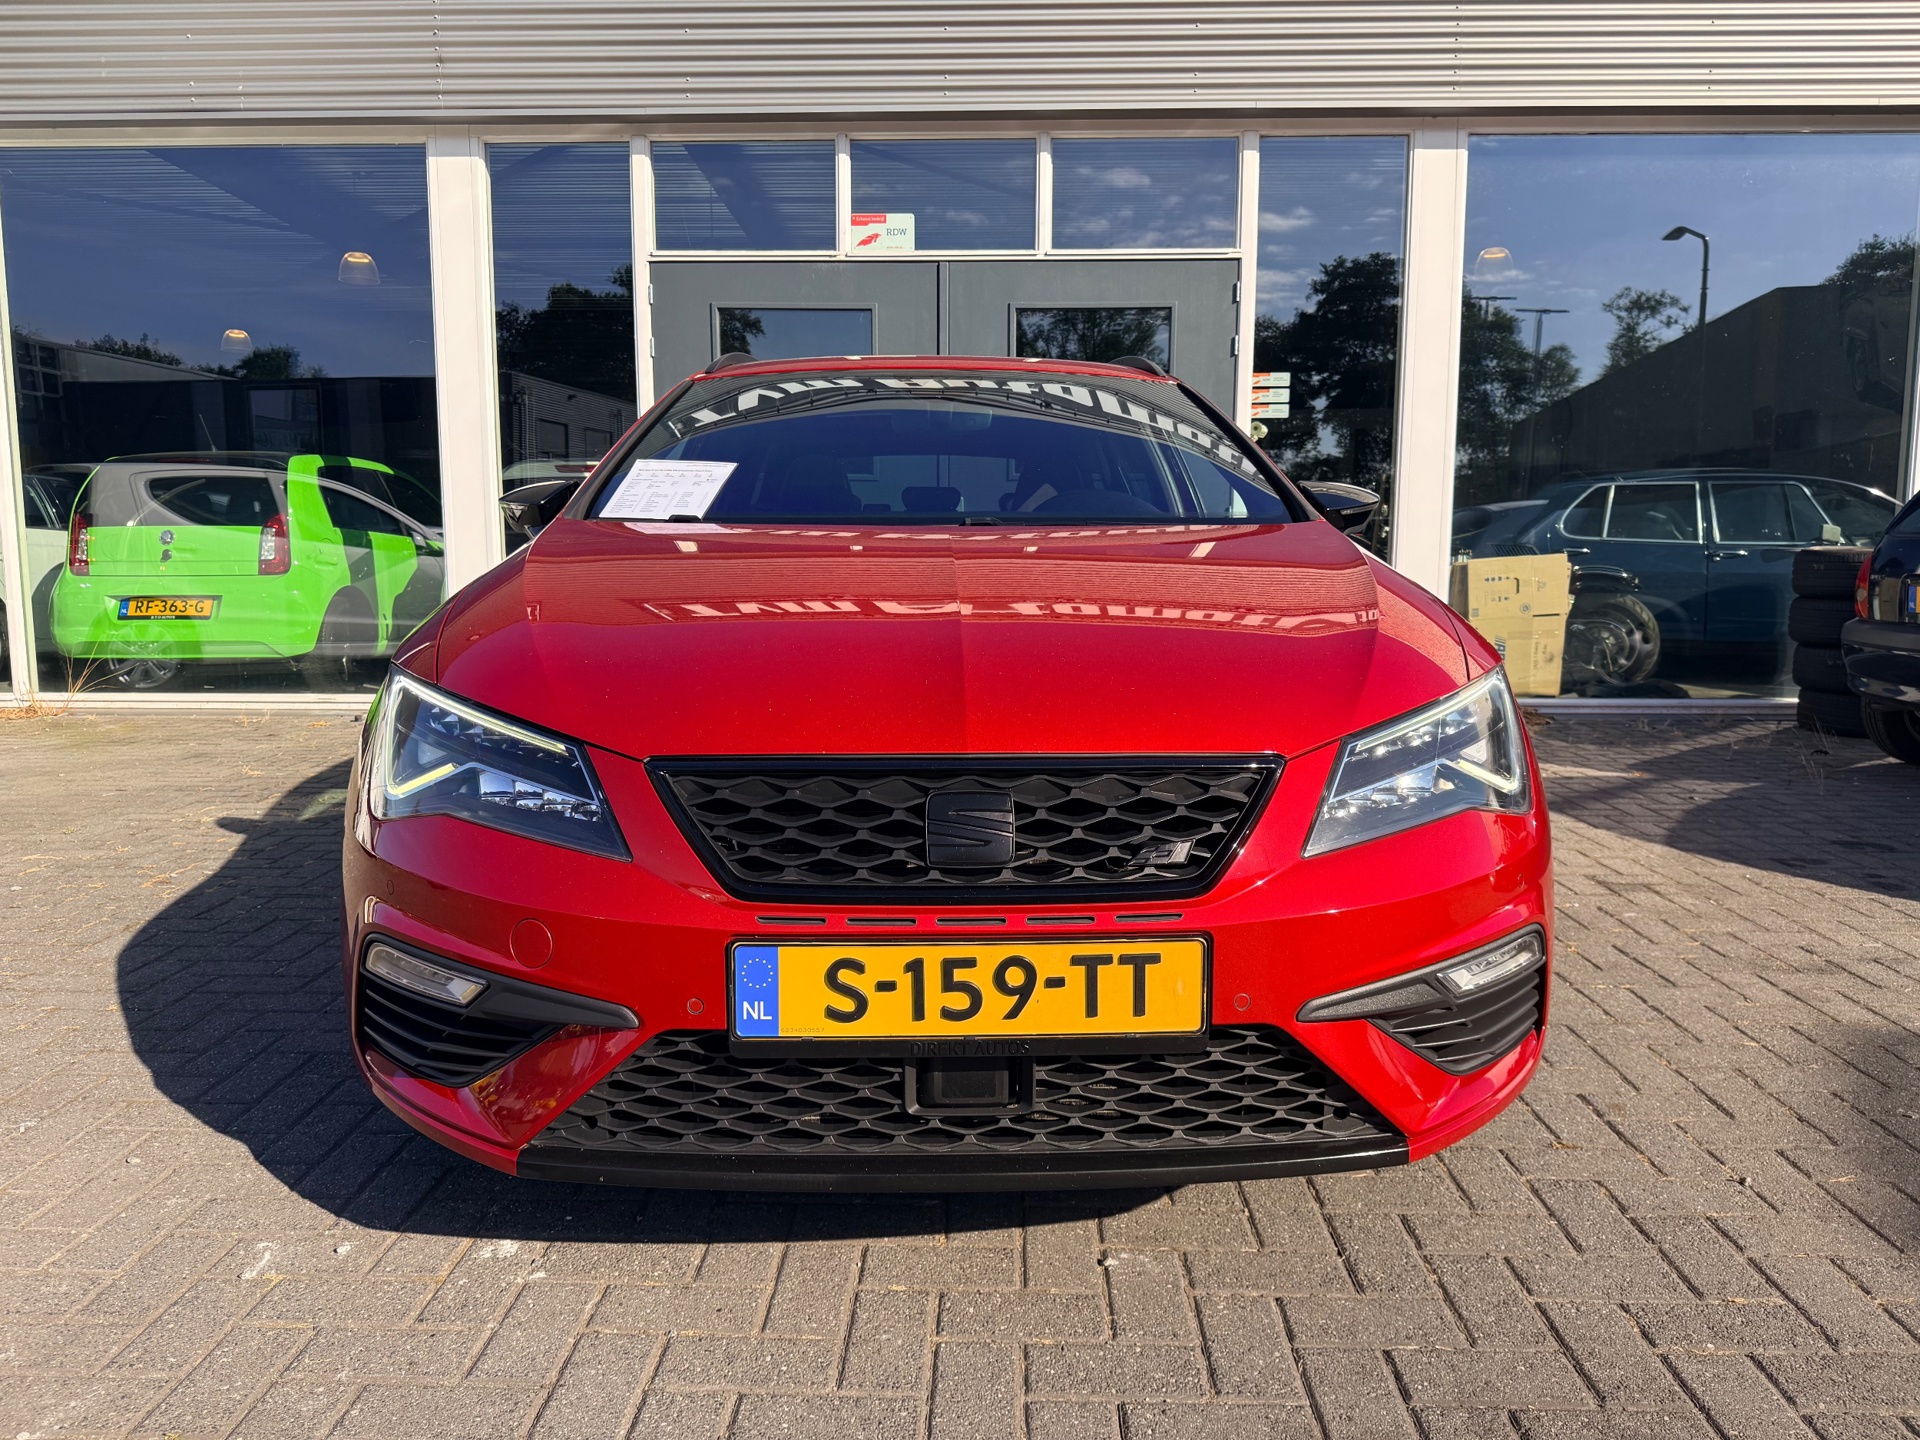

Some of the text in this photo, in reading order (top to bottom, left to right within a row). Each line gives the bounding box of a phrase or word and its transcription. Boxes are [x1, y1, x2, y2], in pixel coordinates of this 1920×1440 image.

[886, 228, 907, 236] RDW
[134, 600, 204, 613] RF-363-G
[742, 953, 1162, 1024] NL S-159-TT
[910, 1040, 1031, 1057] DIREKT AUTOS
